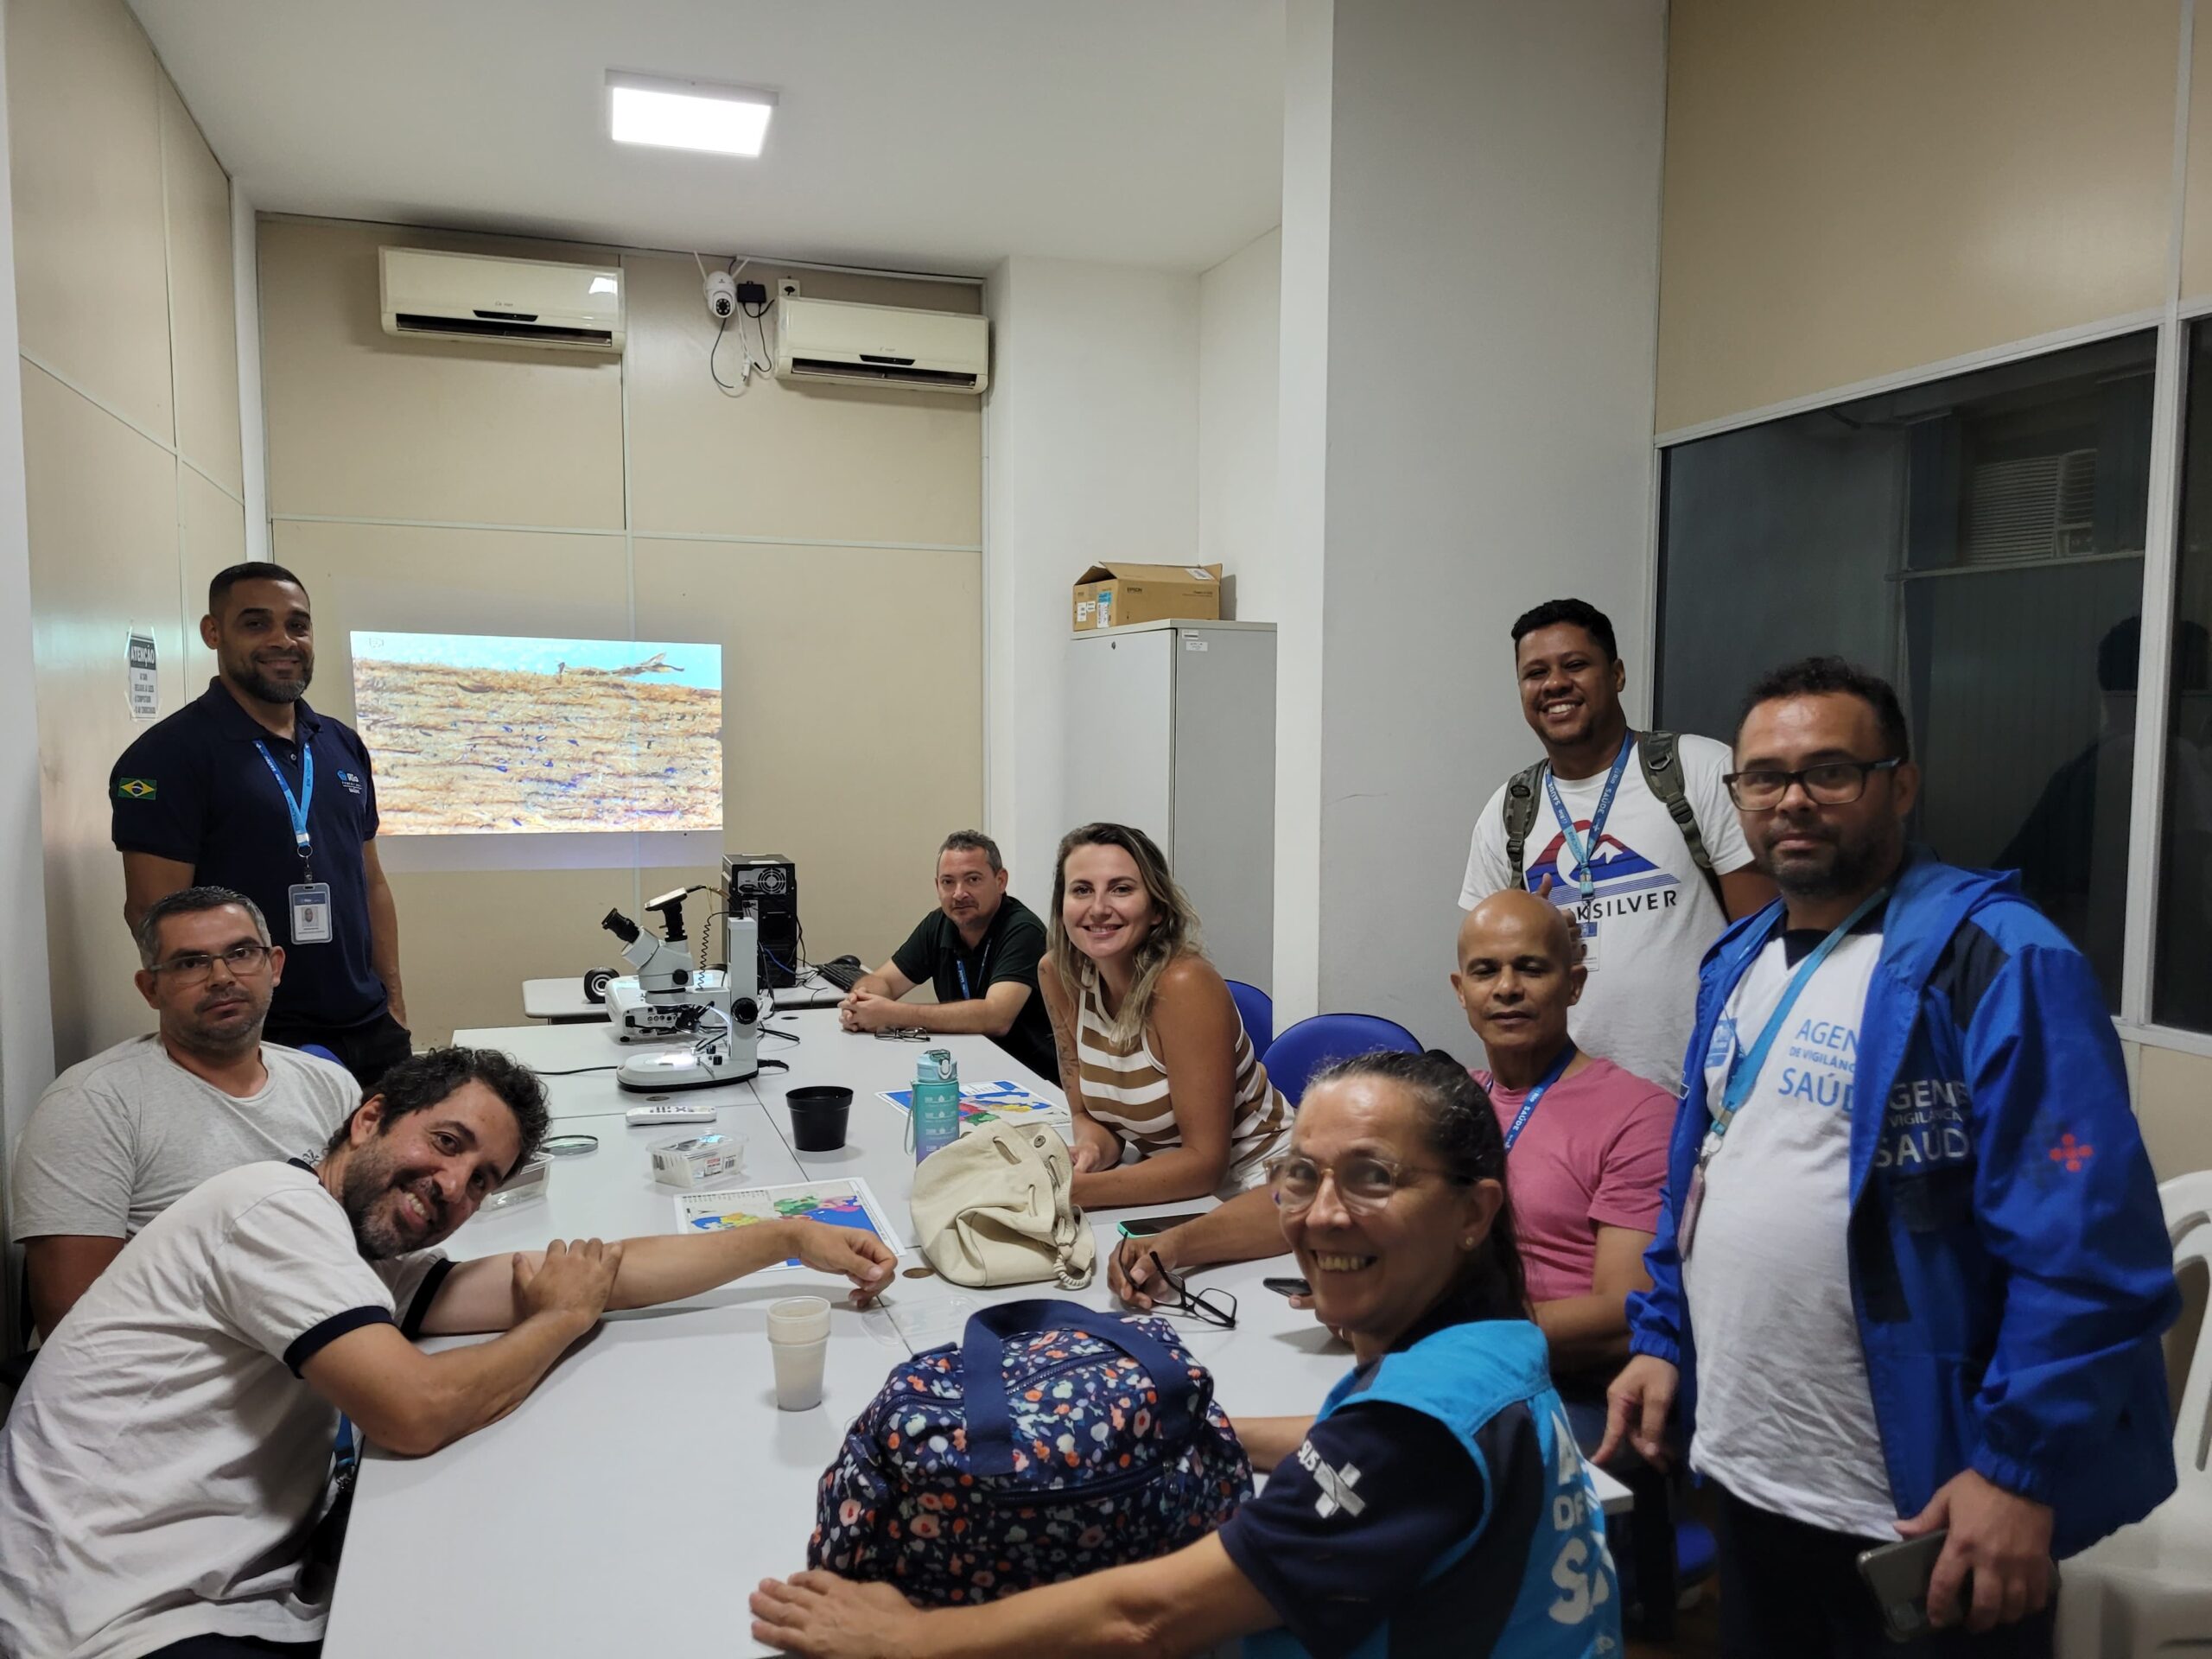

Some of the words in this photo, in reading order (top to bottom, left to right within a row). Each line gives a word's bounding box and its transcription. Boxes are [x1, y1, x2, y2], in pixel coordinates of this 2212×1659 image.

[1598, 787, 1612, 815] SAÚDE
[1570, 889, 1677, 921] KSILVER
[1512, 1105, 1531, 1131] SAÚDE
